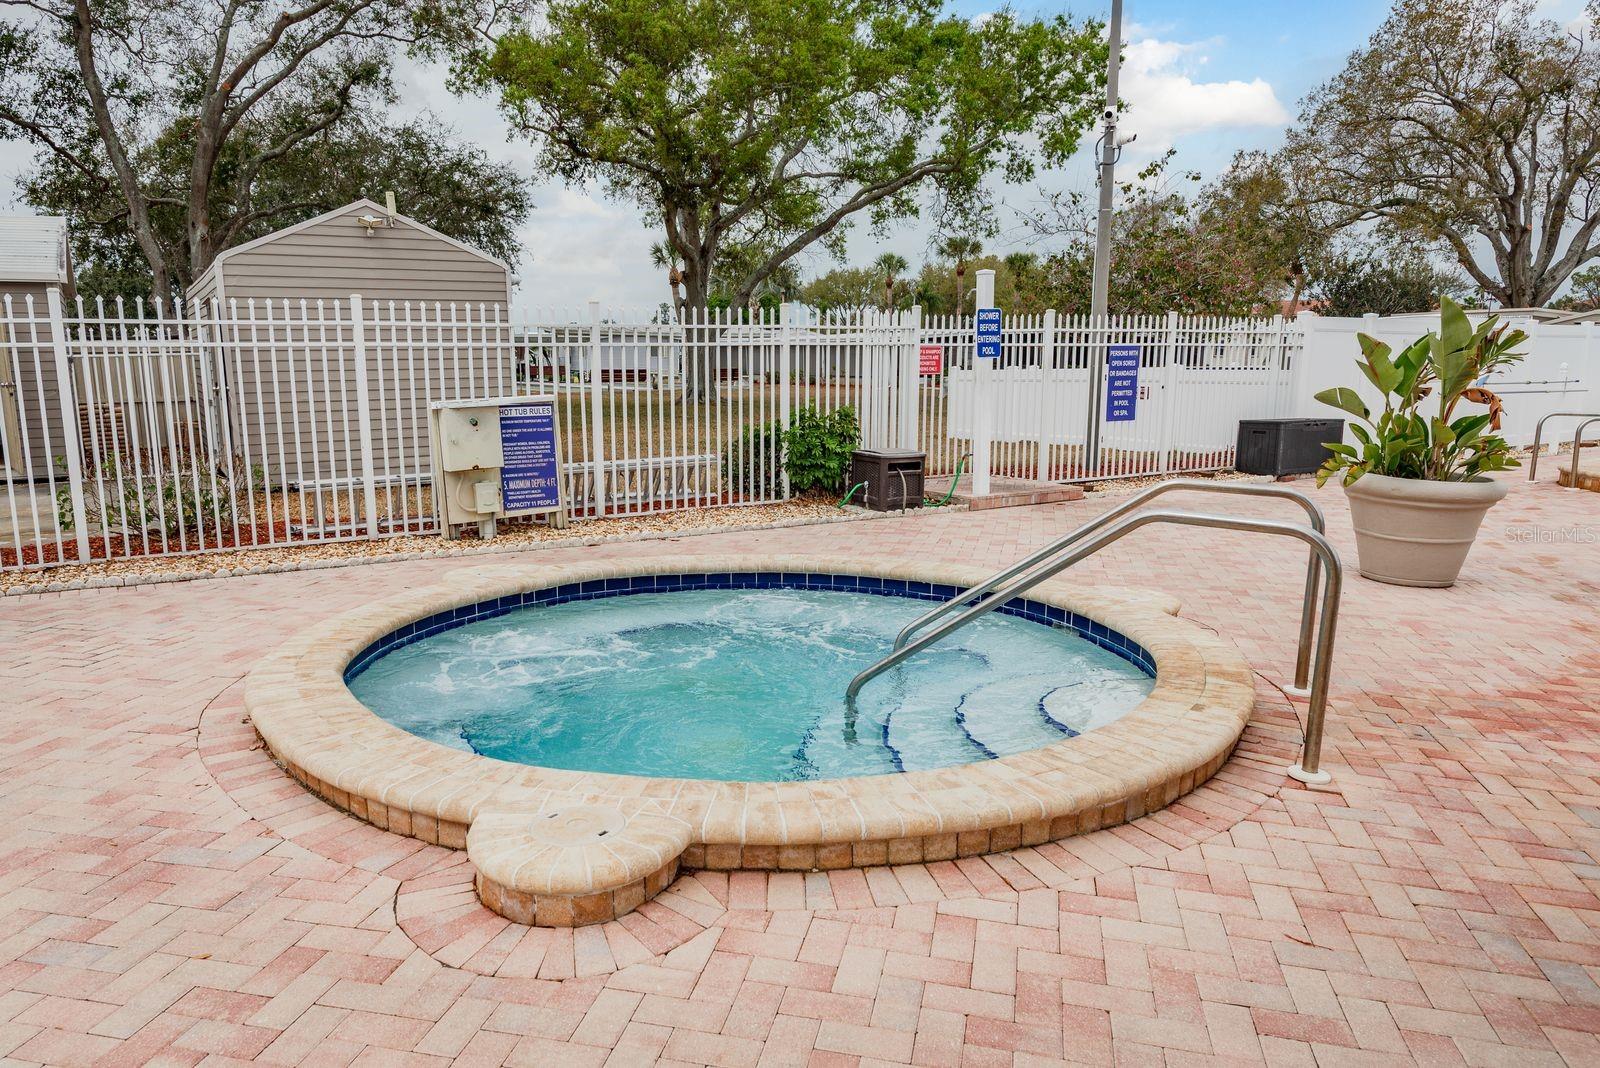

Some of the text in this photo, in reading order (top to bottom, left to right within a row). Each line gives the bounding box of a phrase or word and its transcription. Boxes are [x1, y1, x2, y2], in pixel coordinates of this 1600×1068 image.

[979, 312, 999, 320] SHOWER
[982, 346, 995, 354] POOL
[509, 479, 531, 489] MAXIMUM
[531, 479, 546, 488] DEPTH:
